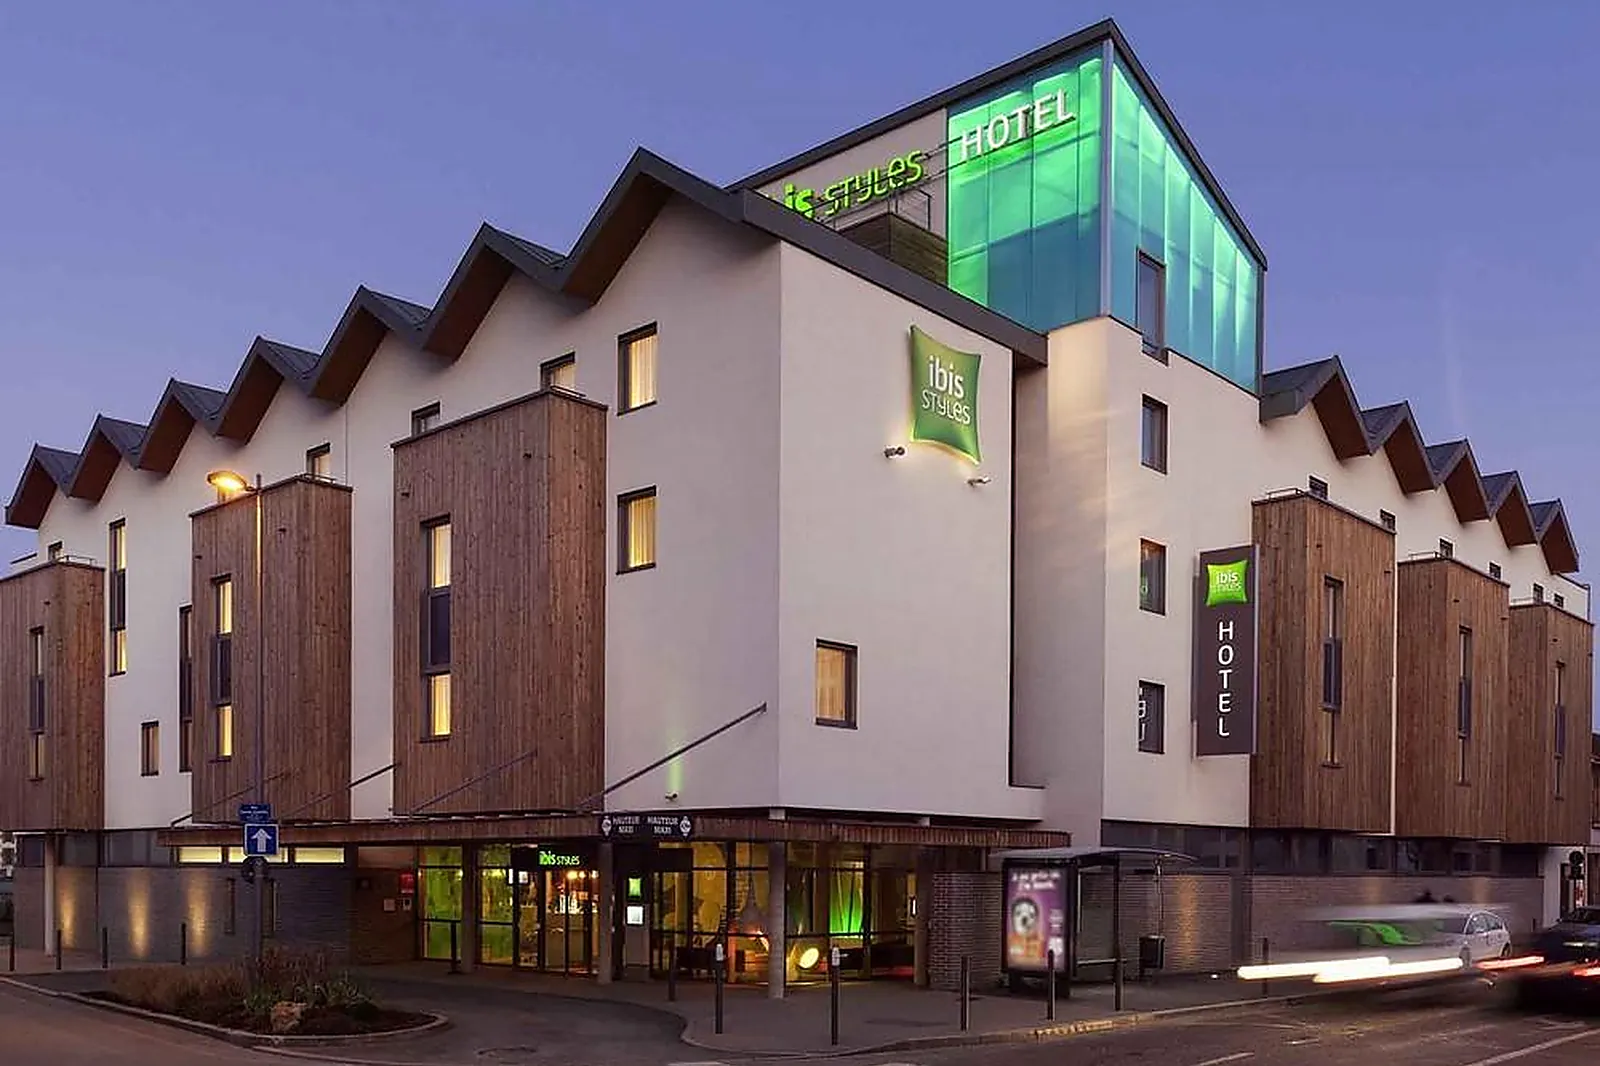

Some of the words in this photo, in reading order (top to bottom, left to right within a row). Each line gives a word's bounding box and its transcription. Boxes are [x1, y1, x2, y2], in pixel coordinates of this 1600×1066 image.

[961, 87, 1075, 161] HOTEL
[783, 183, 815, 219] is
[928, 355, 965, 399] ibis
[1216, 570, 1238, 585] ibis
[1218, 620, 1234, 737] HOTEL
